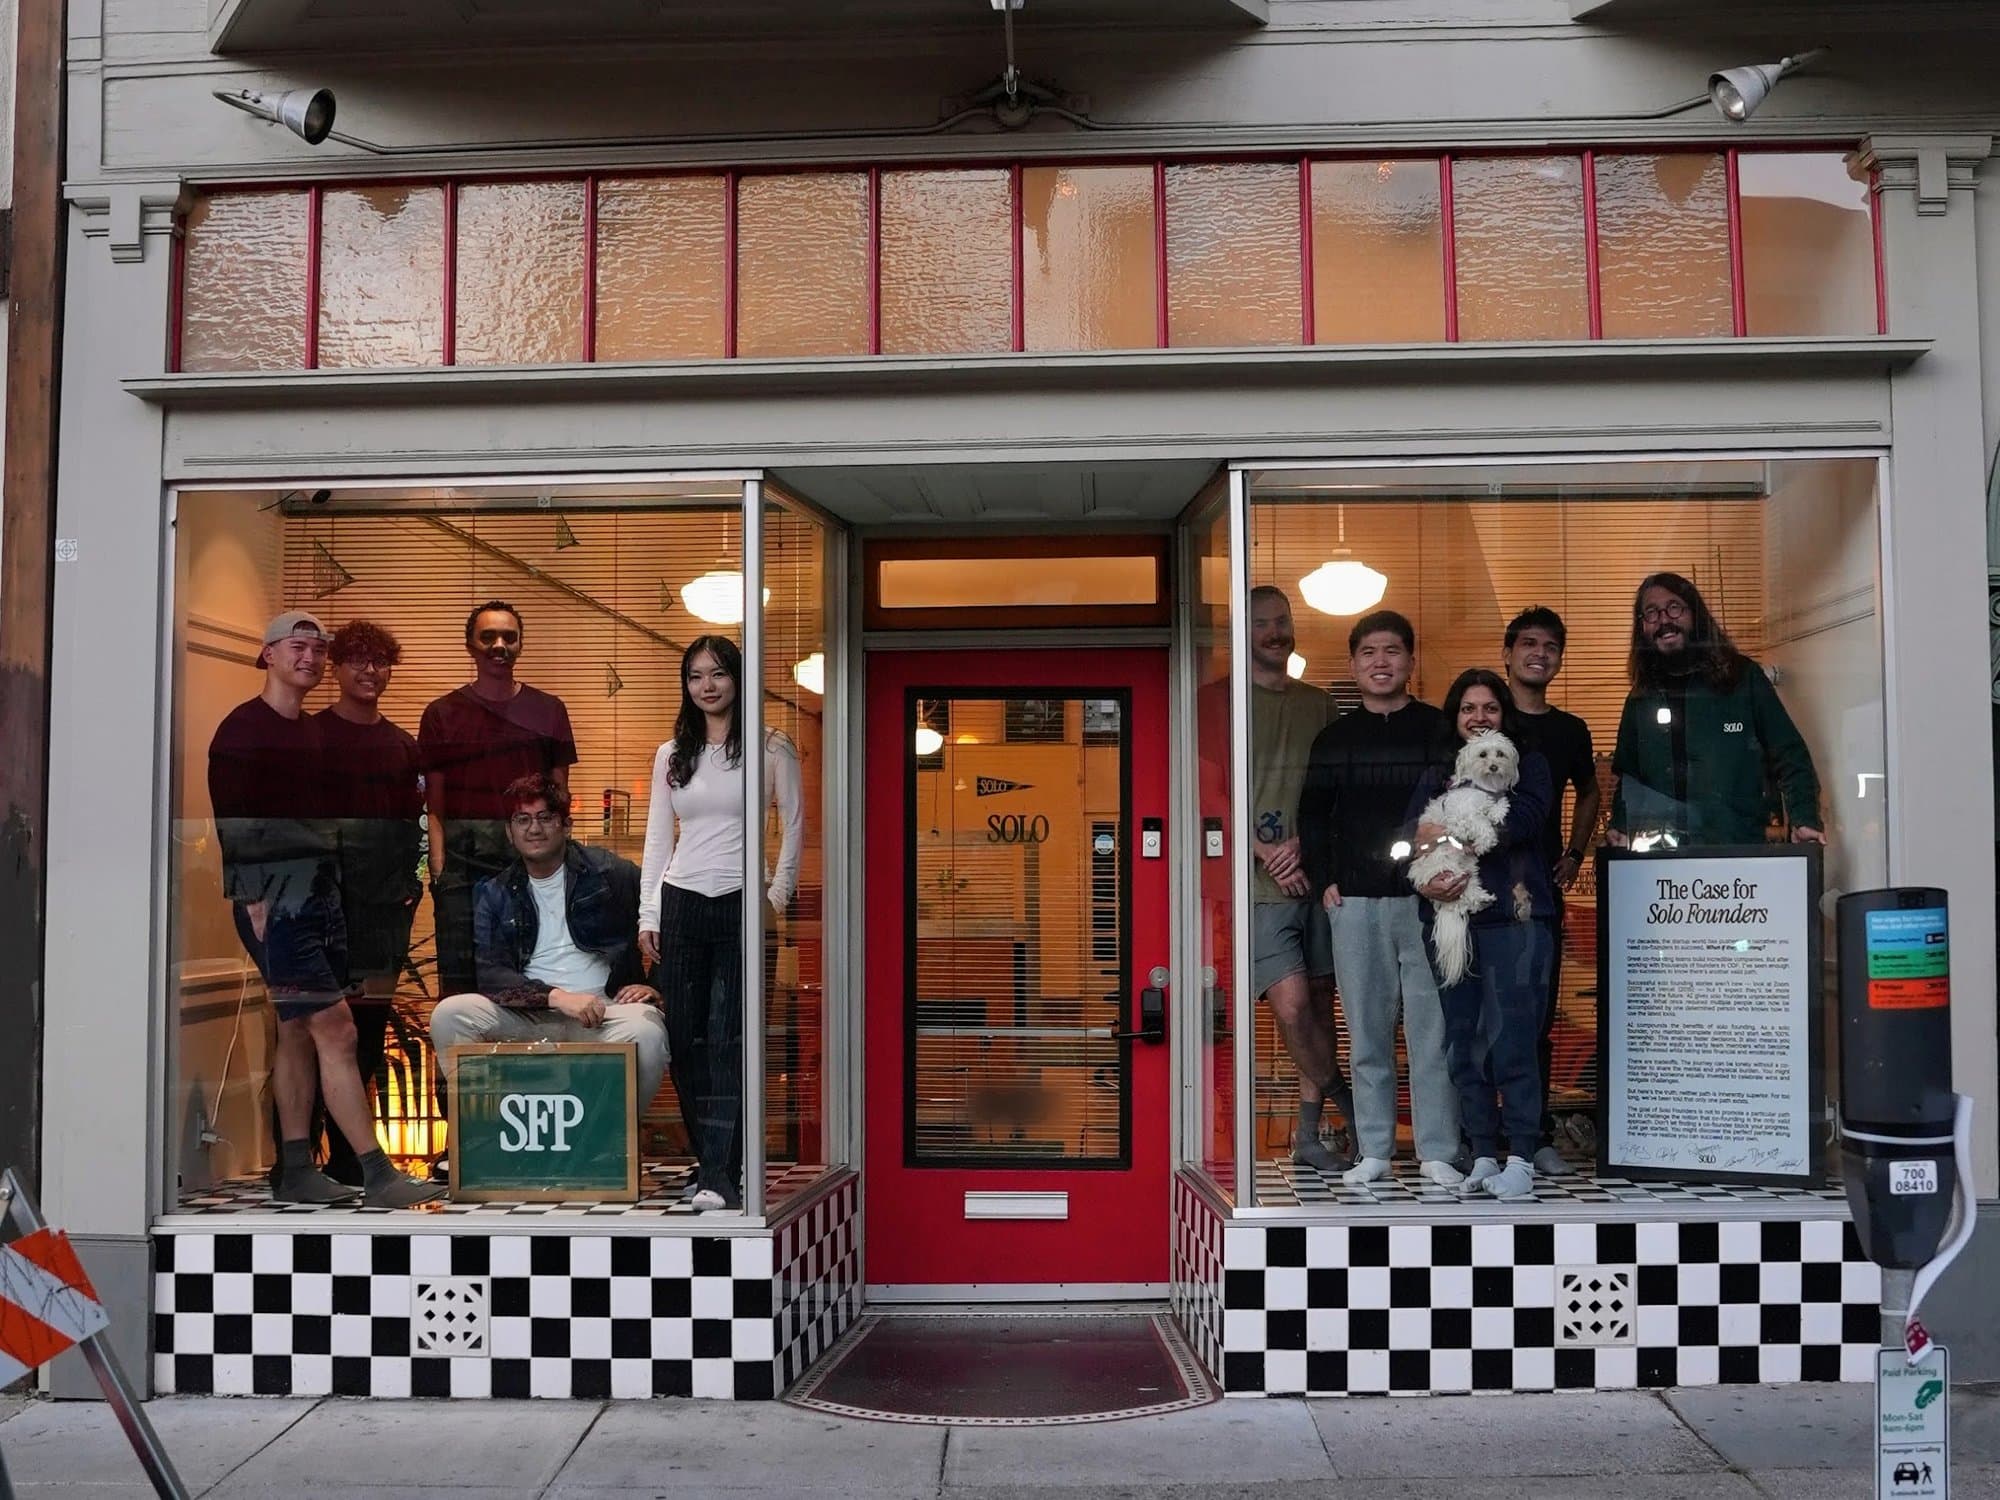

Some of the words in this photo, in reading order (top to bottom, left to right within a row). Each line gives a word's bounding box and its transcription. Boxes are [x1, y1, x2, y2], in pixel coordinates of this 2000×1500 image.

[1723, 722, 1743, 732] SOLO
[980, 779, 1007, 794] SOLO
[987, 814, 1050, 843] SOLO
[1656, 879, 1688, 900] The
[1692, 878, 1729, 900] Case
[1733, 878, 1758, 900] for
[1647, 903, 1684, 924] Solo
[1685, 902, 1768, 924] Founders
[500, 1094, 584, 1152] SFP
[1698, 1155, 1716, 1164] SOLO
[1902, 1168, 1926, 1179] 700
[1895, 1180, 1934, 1192] 08410
[1882, 1369, 1901, 1377] Paid
[1903, 1368, 1937, 1378] Parking
[1882, 1413, 1924, 1422] Mon-Sat
